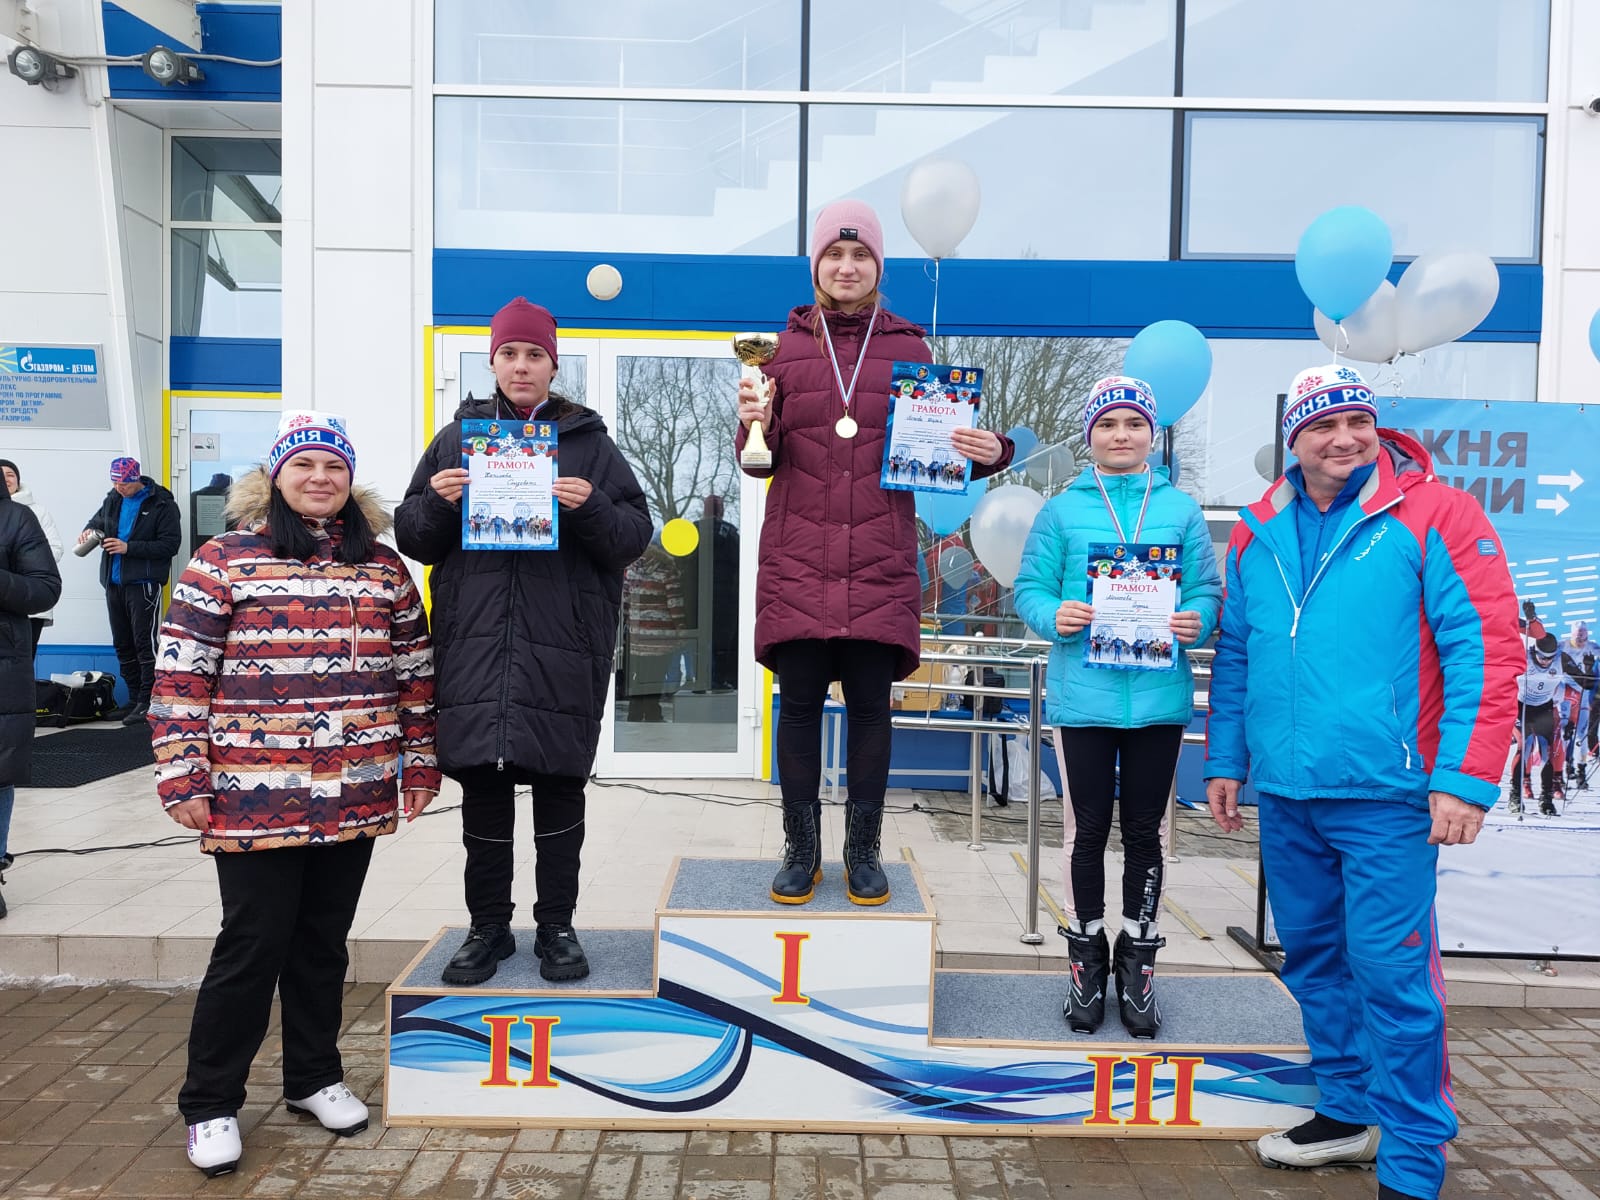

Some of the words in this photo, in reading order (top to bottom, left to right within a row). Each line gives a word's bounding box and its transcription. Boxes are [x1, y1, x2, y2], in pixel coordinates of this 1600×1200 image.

[911, 404, 957, 416] ГРАМОТА
[1135, 391, 1155, 415] РО
[1283, 392, 1331, 436] ЫЖНЯ
[269, 430, 321, 468] ЫЖНЯ
[1400, 428, 1528, 468] ЖНЯ
[487, 460, 535, 470] ГРАМОТА
[1110, 583, 1159, 593] ГРАМОТА
[1537, 681, 1545, 691] 8
[480, 1016, 560, 1088] II
[1084, 1055, 1204, 1126] III
